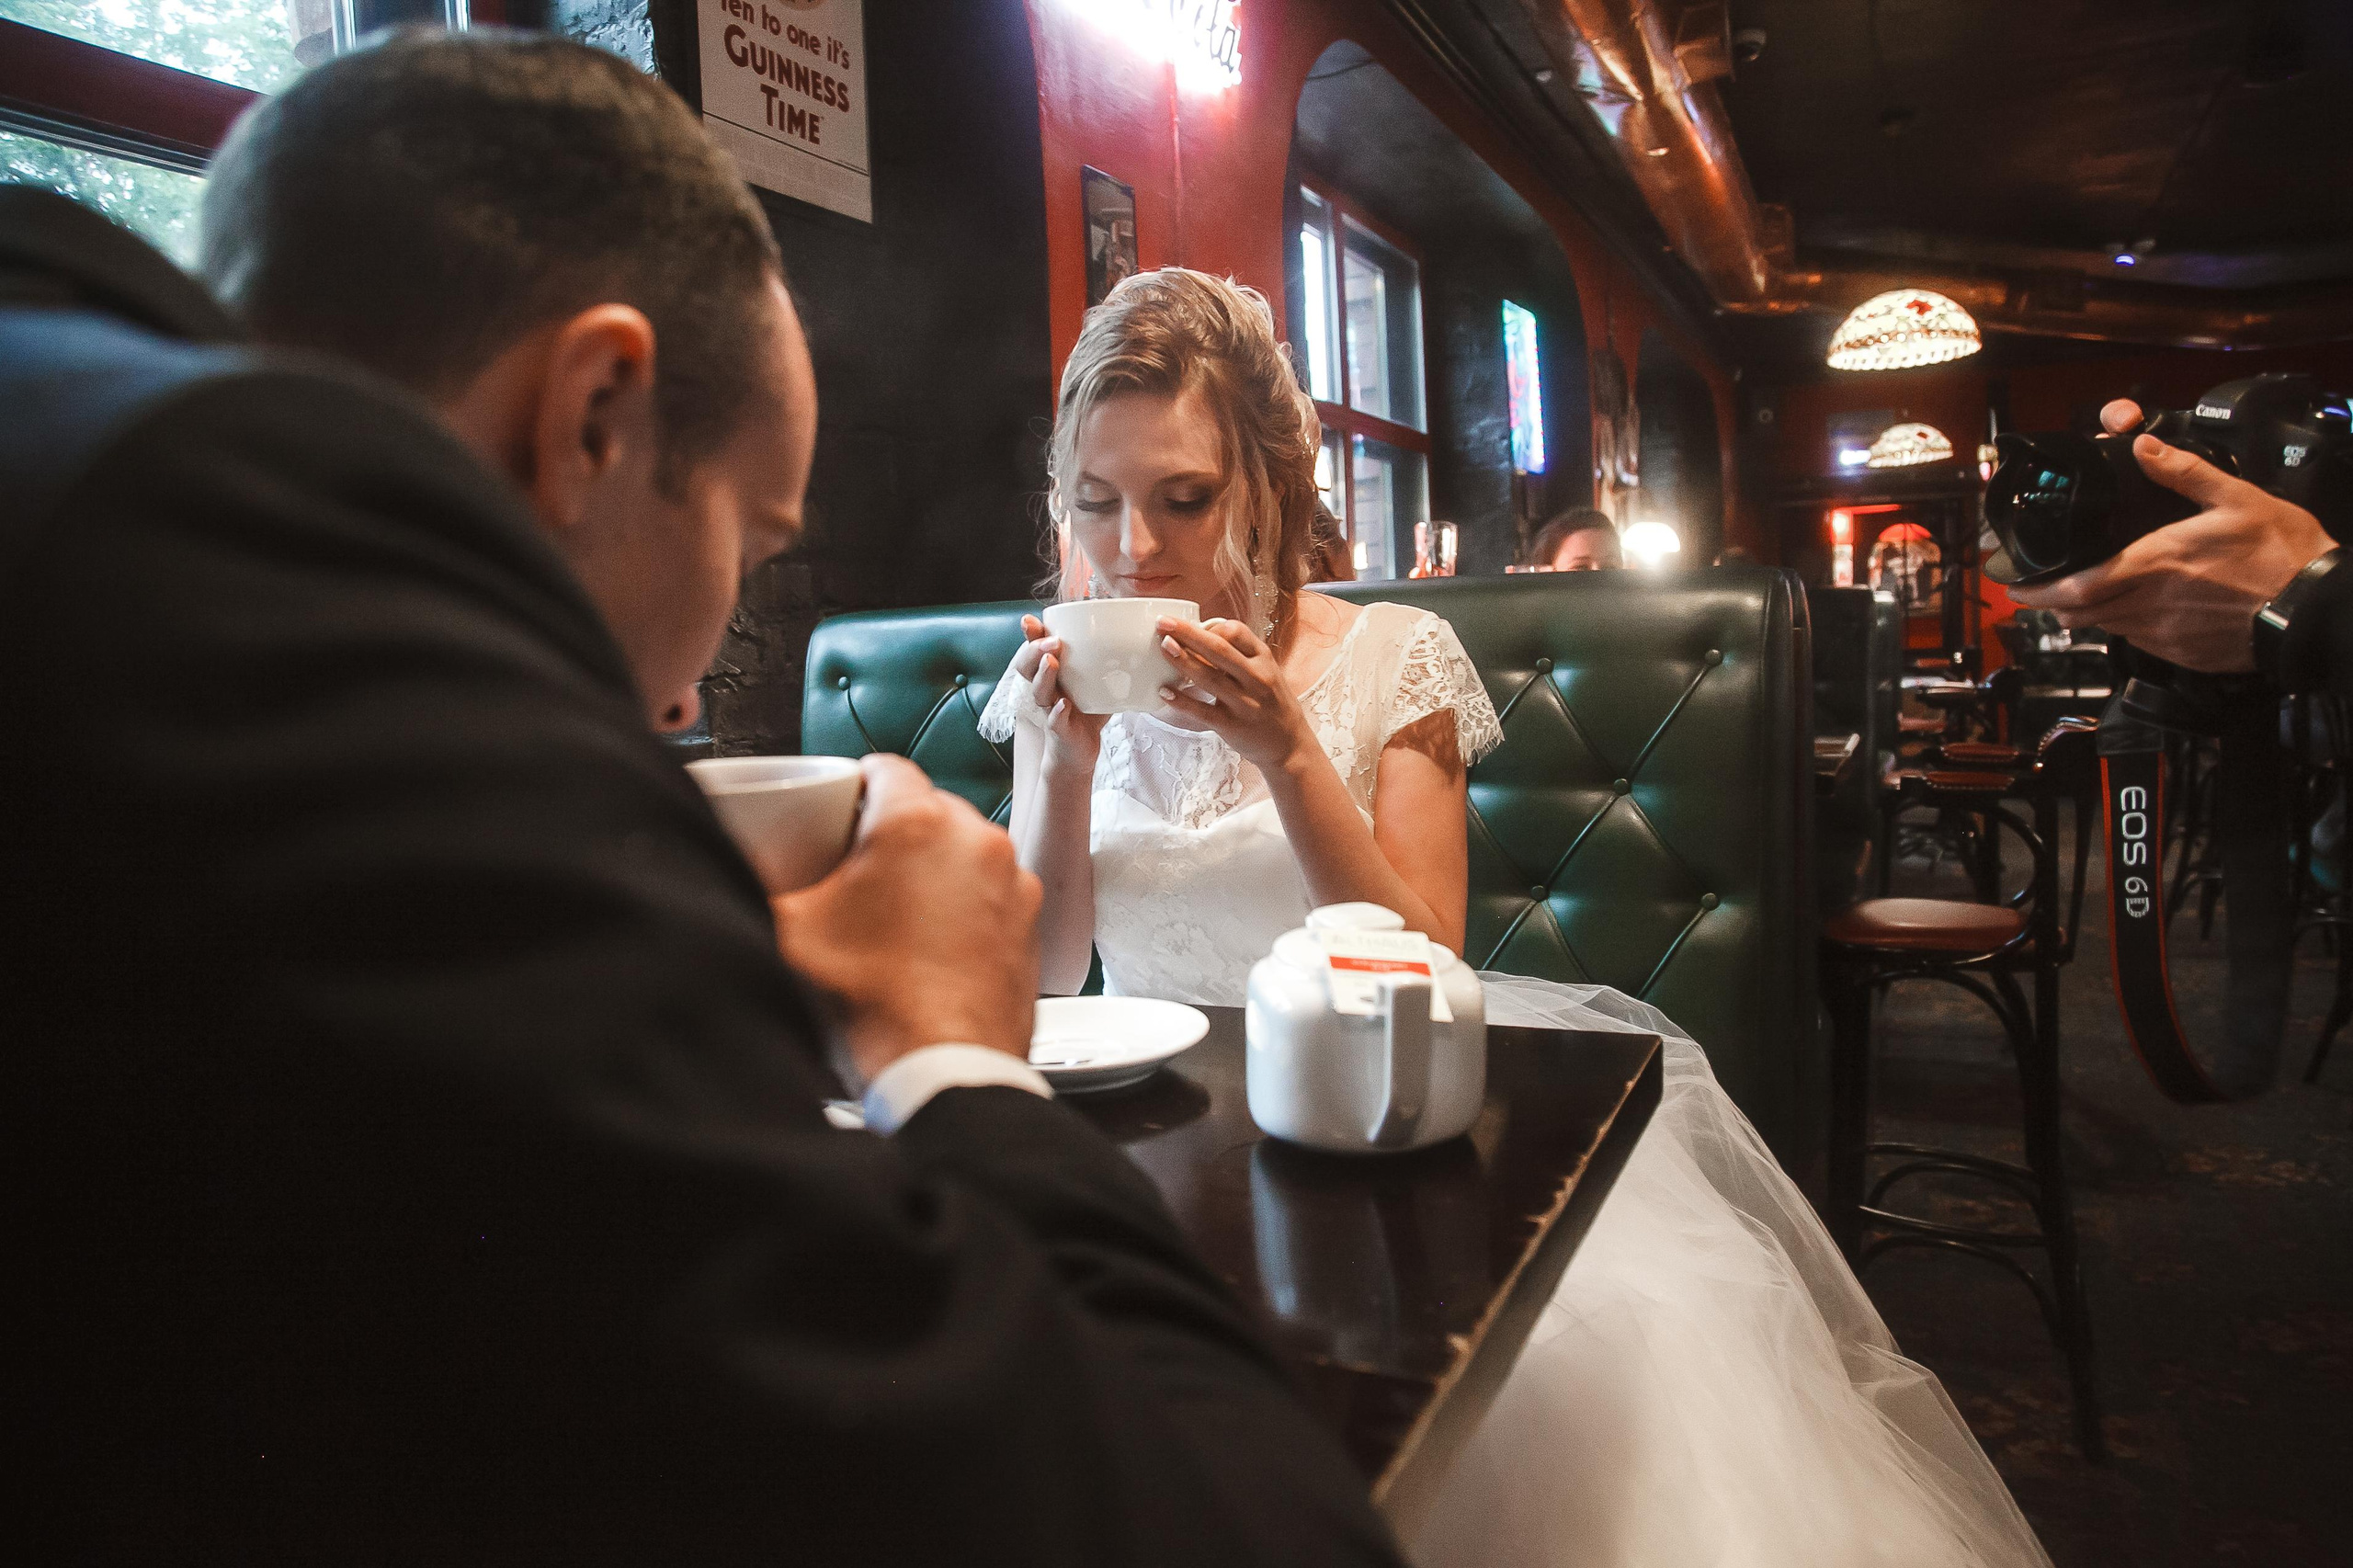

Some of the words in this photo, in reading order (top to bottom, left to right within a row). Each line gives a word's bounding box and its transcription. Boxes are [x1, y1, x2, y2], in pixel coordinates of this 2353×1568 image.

[724, 24, 850, 113] GUINNESS
[762, 4, 781, 36] to
[787, 24, 821, 55] one
[827, 36, 850, 70] it's
[760, 83, 821, 145] TIME
[2120, 786, 2147, 866] EOS
[2125, 876, 2149, 918] 6D
